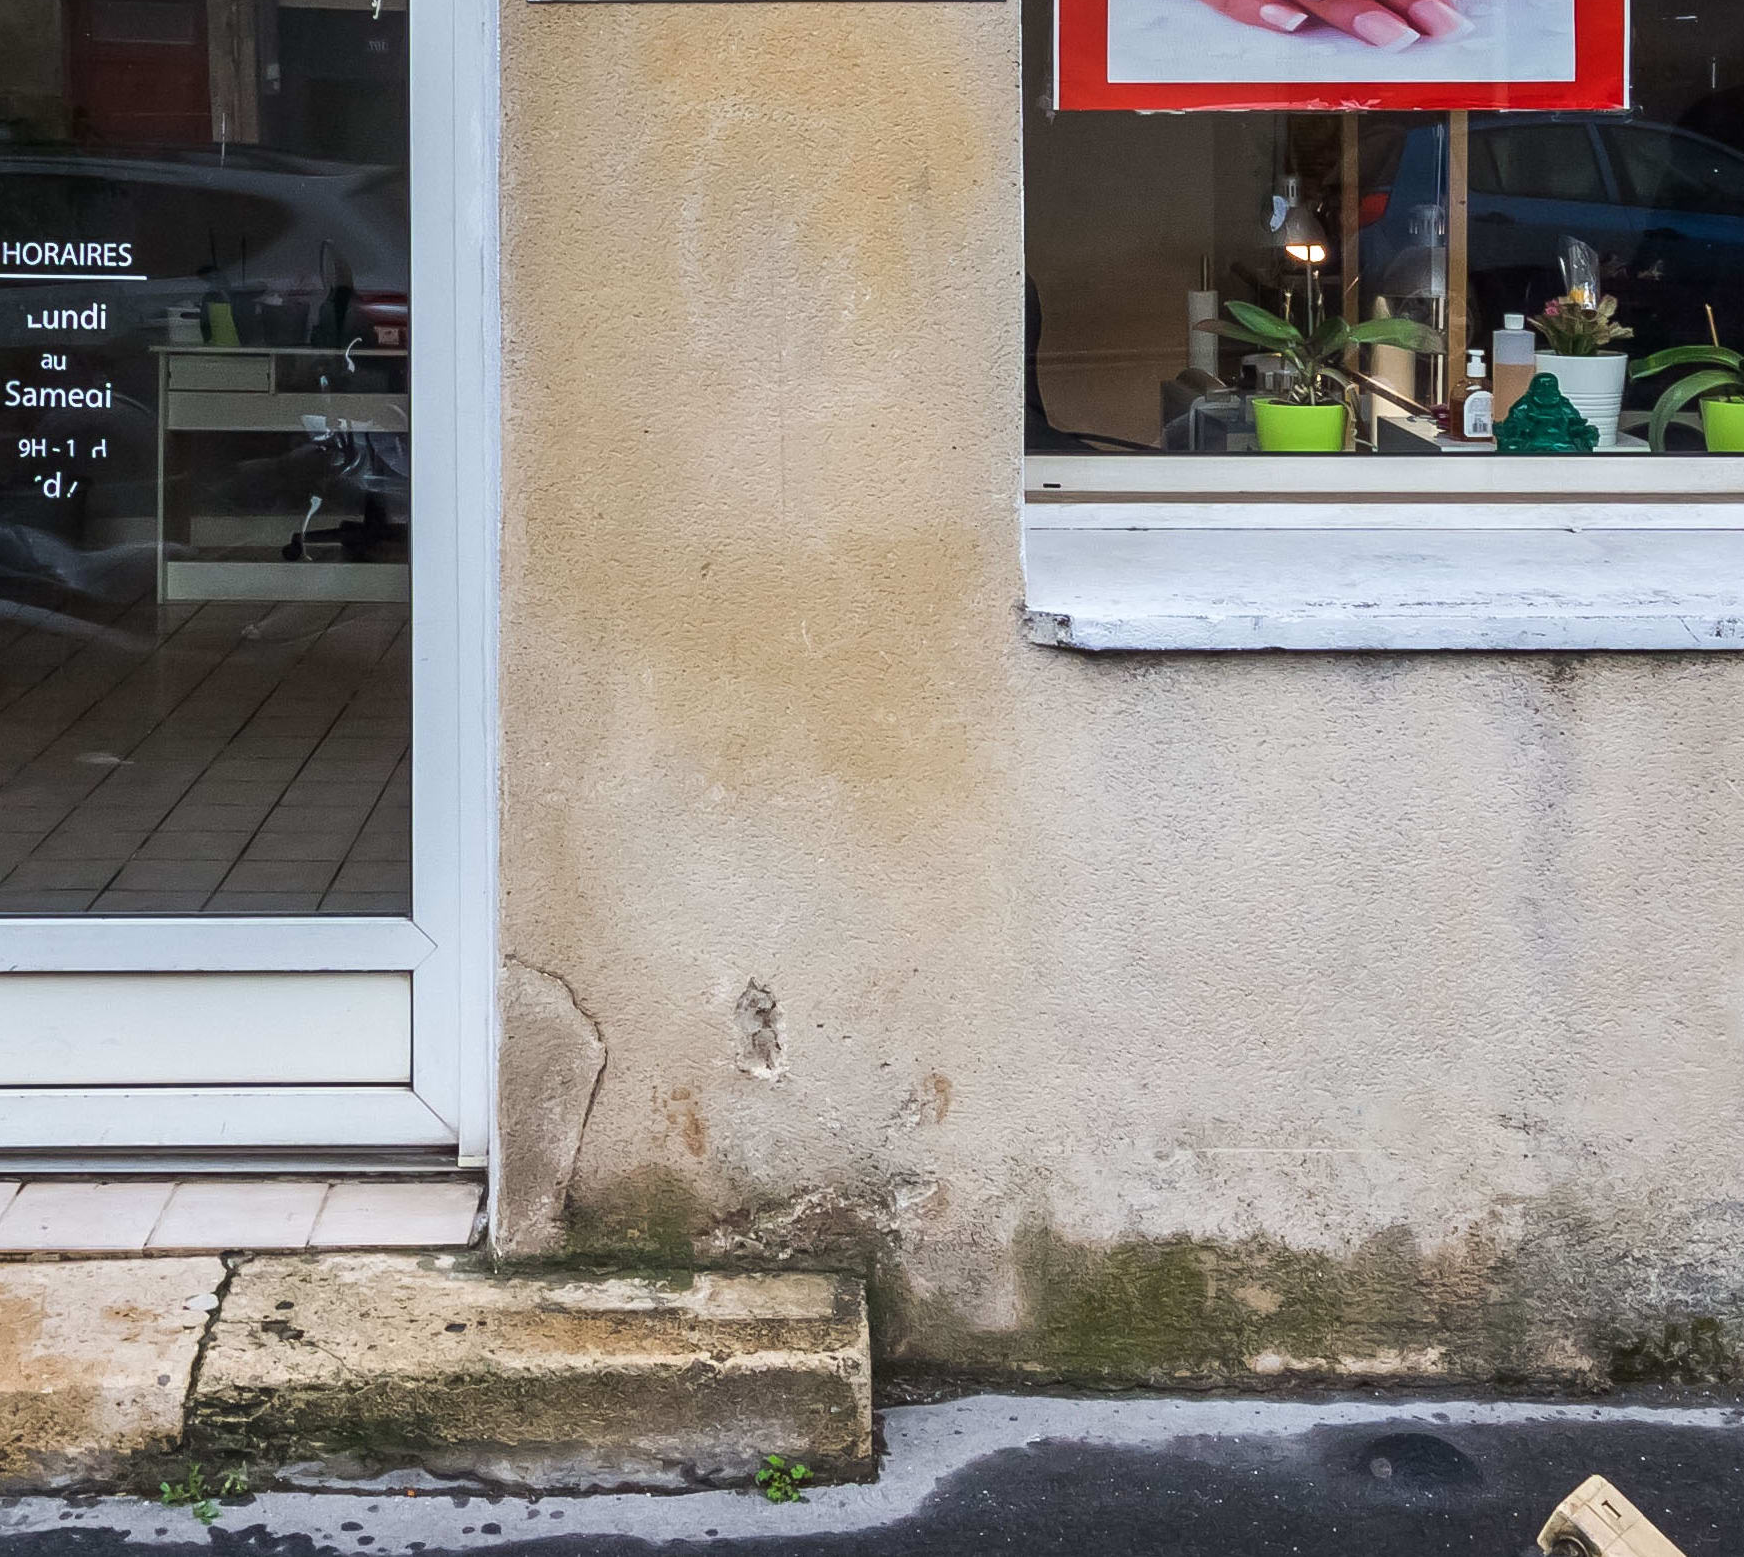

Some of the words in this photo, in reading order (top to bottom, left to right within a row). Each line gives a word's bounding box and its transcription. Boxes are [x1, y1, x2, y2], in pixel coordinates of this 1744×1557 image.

[2, 241, 133, 267] HORAIRES
[40, 353, 67, 371] au
[18, 438, 47, 458] 9H
